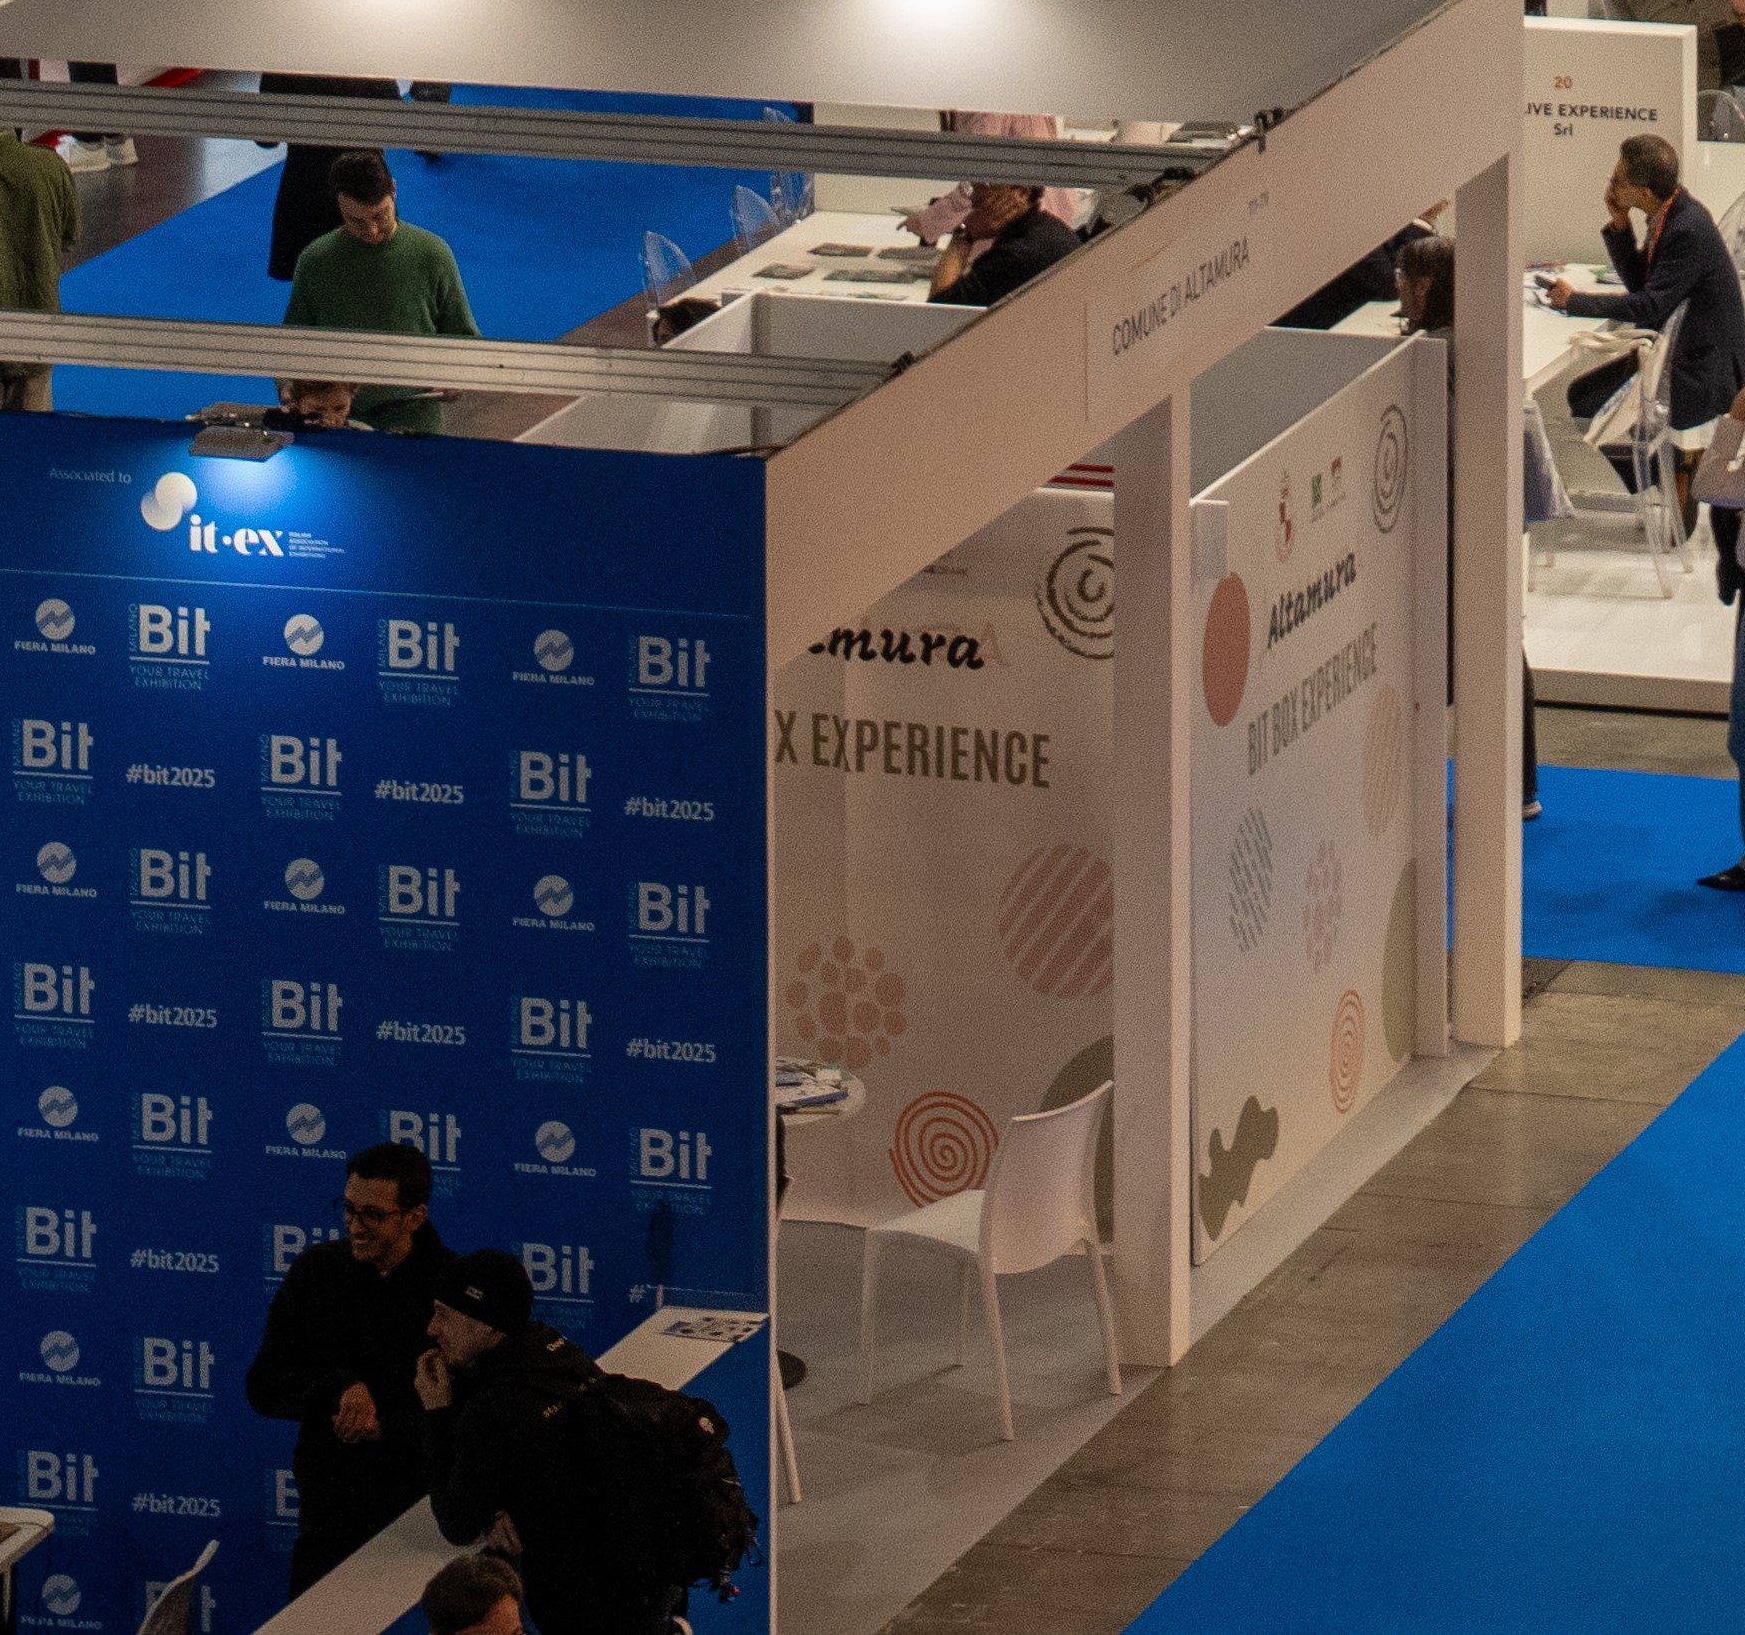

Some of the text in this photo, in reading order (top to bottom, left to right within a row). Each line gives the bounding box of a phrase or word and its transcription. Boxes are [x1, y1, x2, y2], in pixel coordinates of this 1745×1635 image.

[1554, 76, 1573, 89] 20
[1524, 102, 1658, 121] IVE EXPERIENCE
[1553, 123, 1573, 136] Srl
[1112, 236, 1250, 355] COMUNE DI ALTAMURA
[49, 467, 132, 485] Associated to
[1267, 552, 1357, 650] Altamura
[138, 604, 211, 655] Bit
[808, 625, 986, 672] mura
[1272, 686, 1299, 757] BOX
[1302, 620, 1378, 734] EXPERIENCE
[811, 711, 1052, 790] EXPERIENCE
[374, 779, 464, 804] #bit2025
